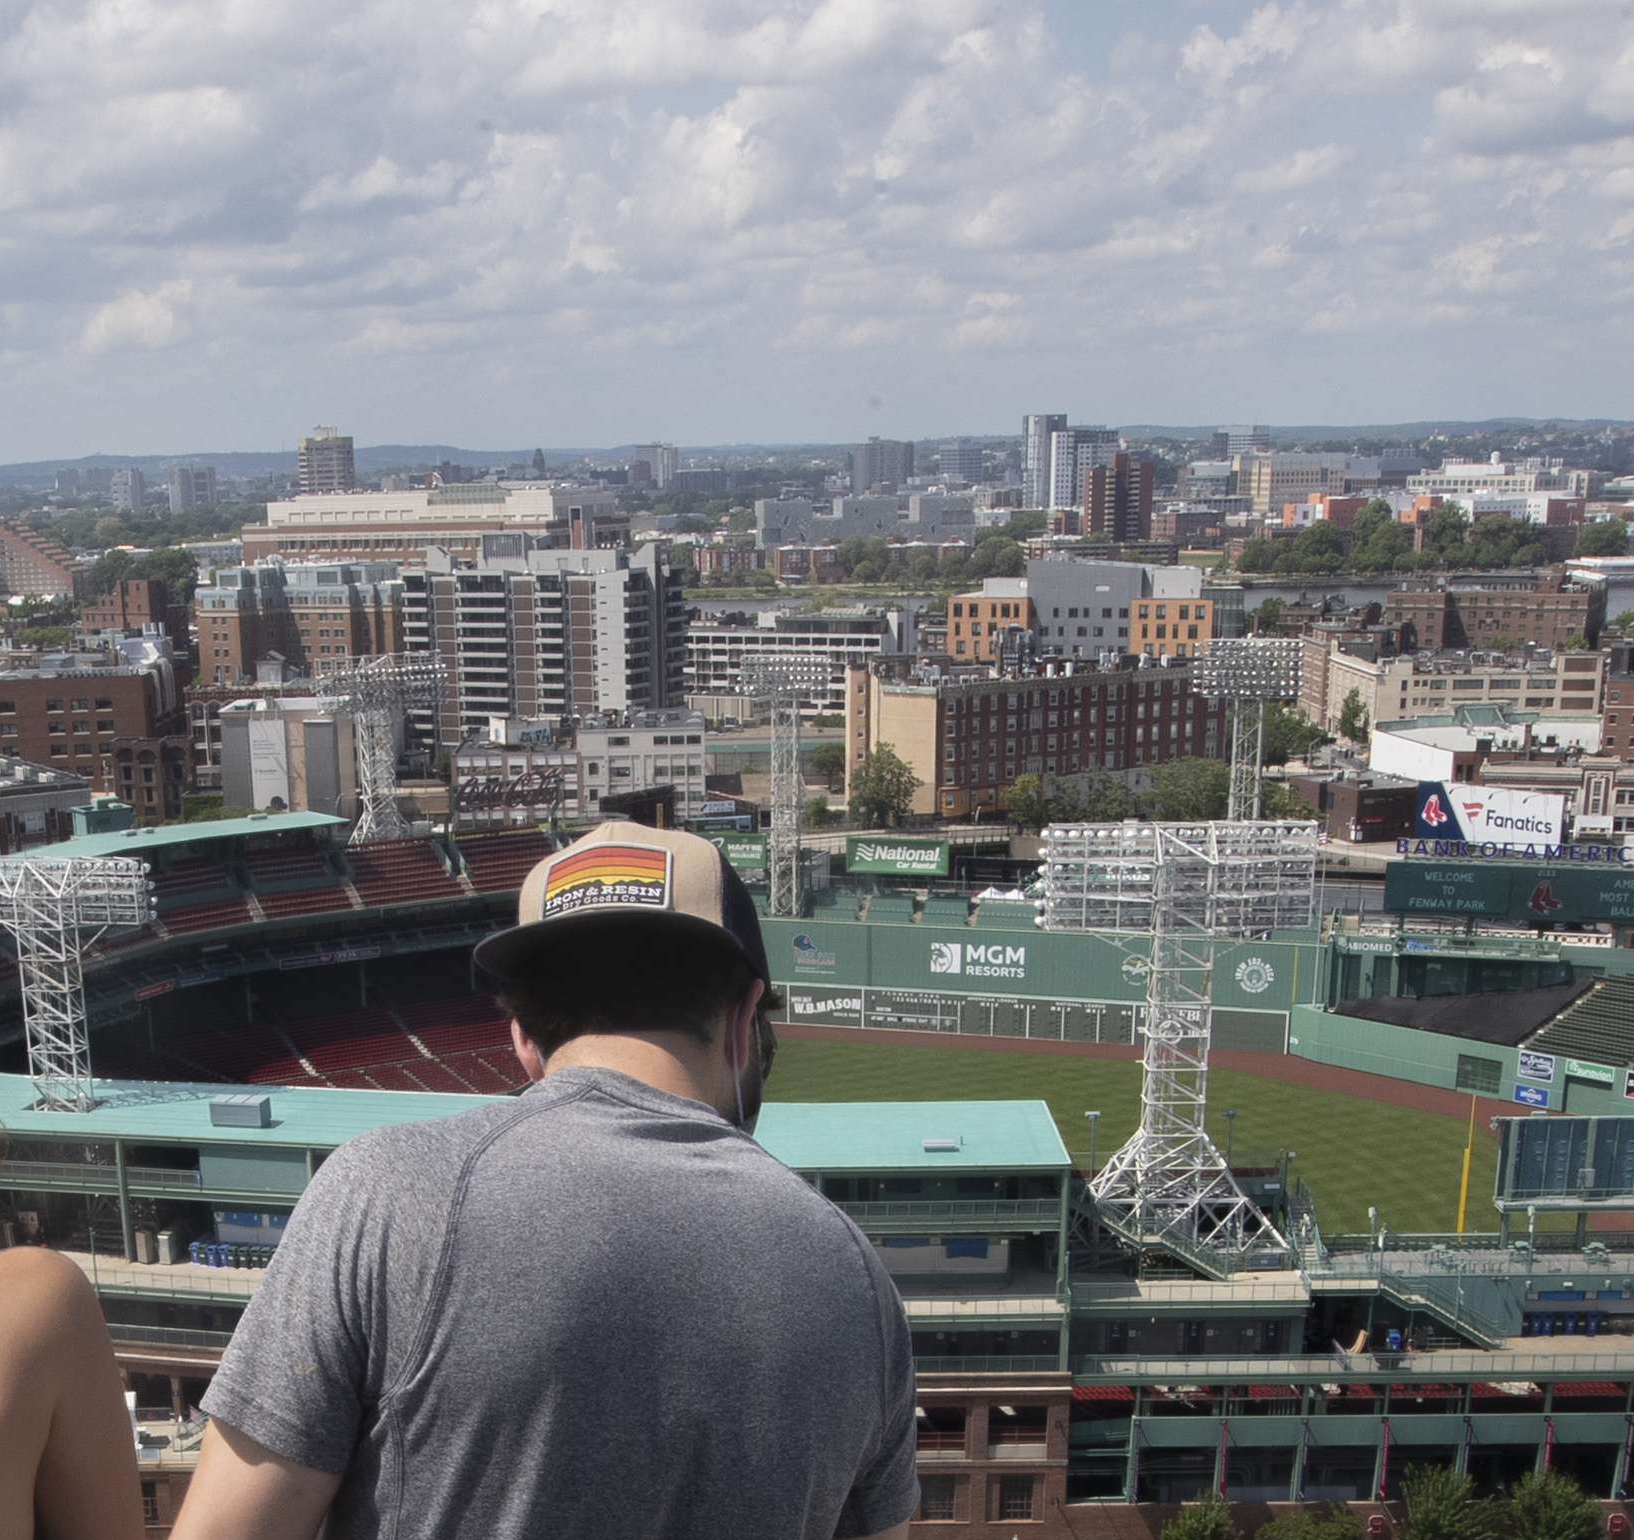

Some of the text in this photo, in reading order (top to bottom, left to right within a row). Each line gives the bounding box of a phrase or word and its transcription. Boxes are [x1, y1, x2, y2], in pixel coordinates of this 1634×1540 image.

[1486, 810, 1552, 834] Fanatics
[727, 844, 763, 852] MAPFRE
[1396, 838, 1467, 858] BANK
[1480, 841, 1515, 859] OF
[897, 861, 937, 870] Car Rental
[1424, 871, 1475, 883] WELCOME
[1442, 885, 1455, 895] TO
[546, 885, 662, 909] IRON & RESIN
[562, 899, 581, 910] Dry
[584, 895, 619, 904] Goods
[1408, 897, 1485, 910] FENWAY PARK
[1599, 892, 1630, 902] MOST
[1346, 942, 1392, 953] ABIOMED
[966, 943, 1025, 966] MGM
[966, 965, 1025, 978] RESORTS
[1368, 1514, 1386, 1536] 9
[1607, 1512, 1626, 1534] 8
